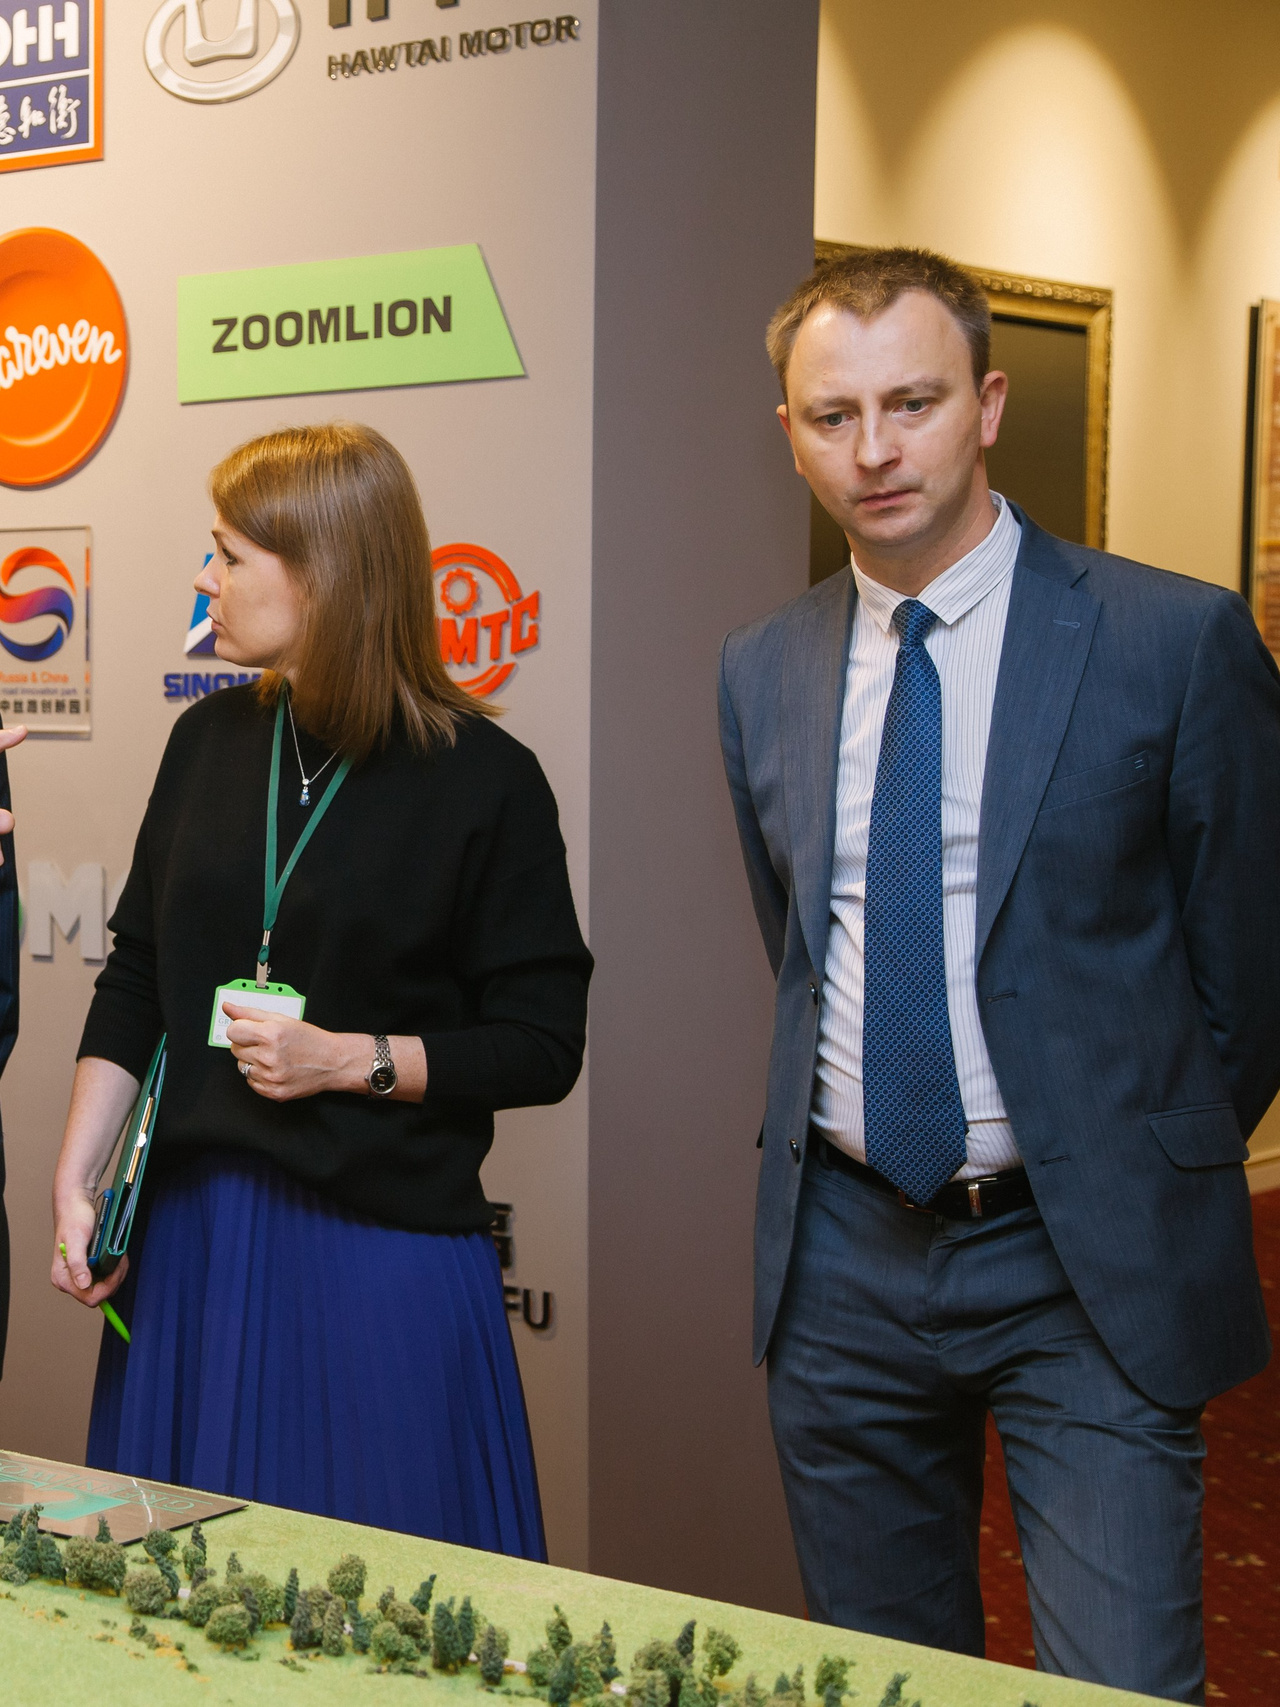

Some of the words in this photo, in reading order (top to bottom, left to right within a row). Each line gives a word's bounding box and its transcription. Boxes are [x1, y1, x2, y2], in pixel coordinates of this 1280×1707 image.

[327, 36, 452, 80] HAWTAI
[459, 15, 581, 58] MOTOR
[212, 295, 452, 353] ZOOMLION
